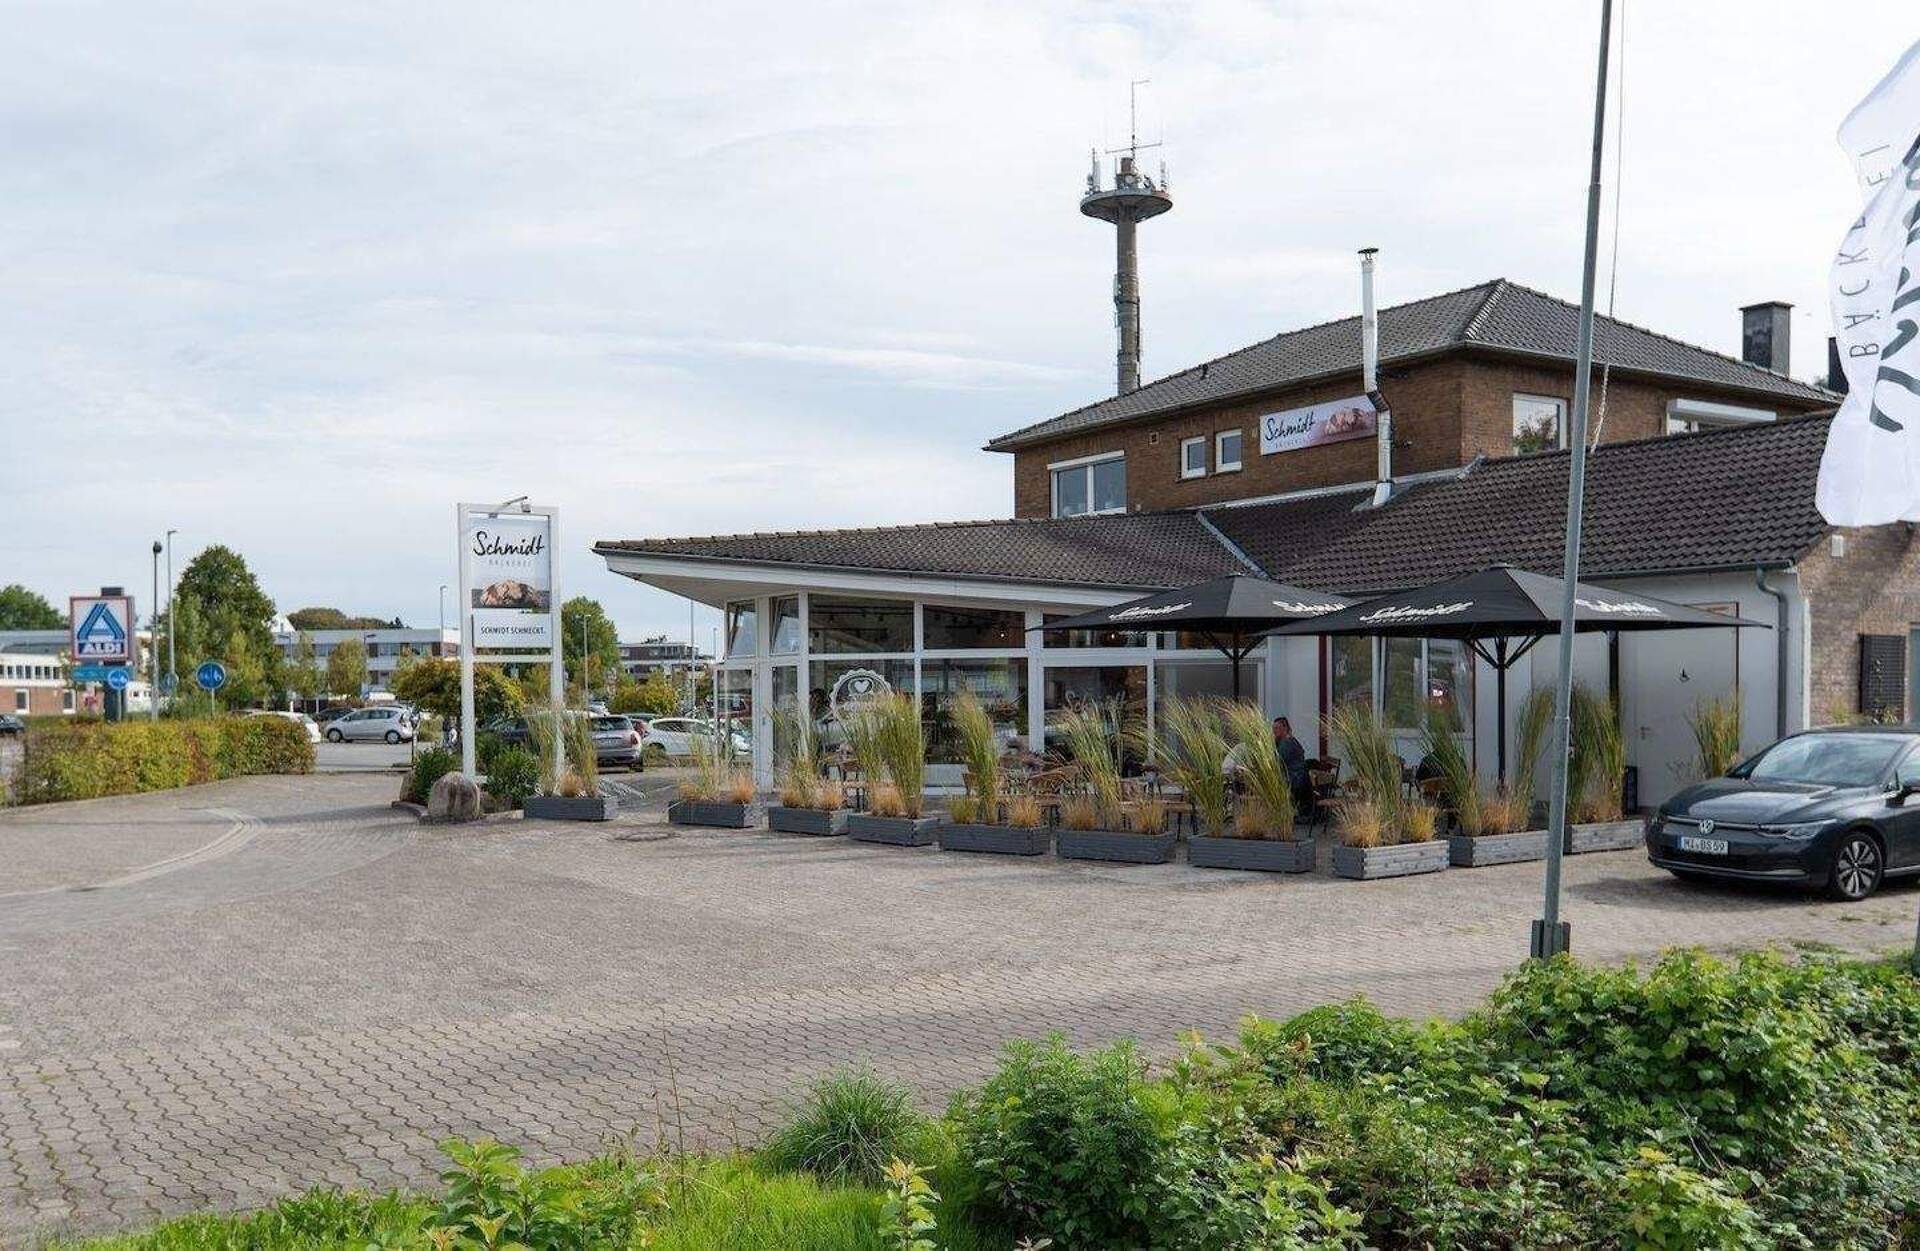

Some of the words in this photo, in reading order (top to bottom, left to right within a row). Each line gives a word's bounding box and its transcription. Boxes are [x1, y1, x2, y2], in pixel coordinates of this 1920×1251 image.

[1265, 411, 1316, 441] Schmidt
[473, 530, 545, 556] Schmidt
[480, 626, 510, 635] SCHMIDT
[82, 642, 121, 655] ALDI
